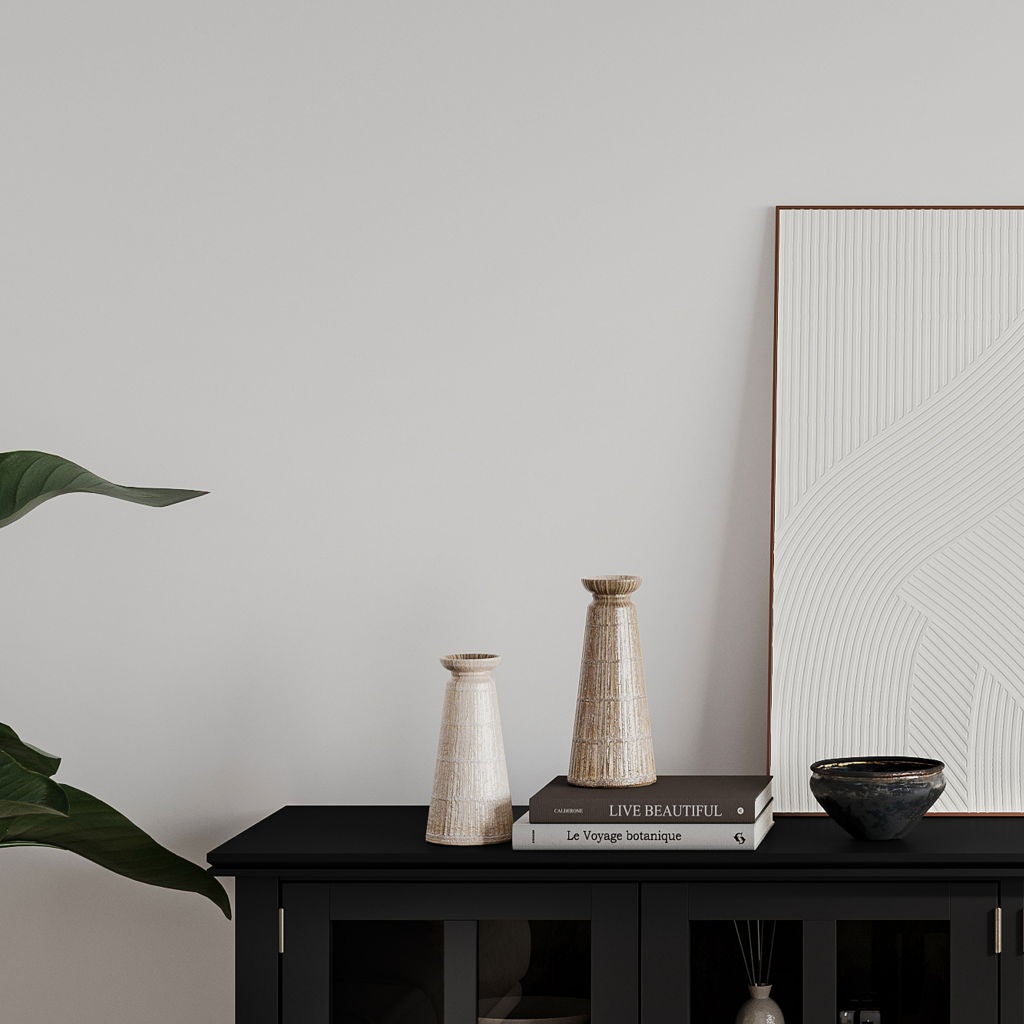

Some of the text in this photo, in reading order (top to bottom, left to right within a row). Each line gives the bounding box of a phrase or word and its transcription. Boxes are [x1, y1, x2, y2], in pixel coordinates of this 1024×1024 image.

[609, 805, 722, 817] LIVE BEAUTIFUL
[567, 829, 682, 844] Le Voyage botanique
